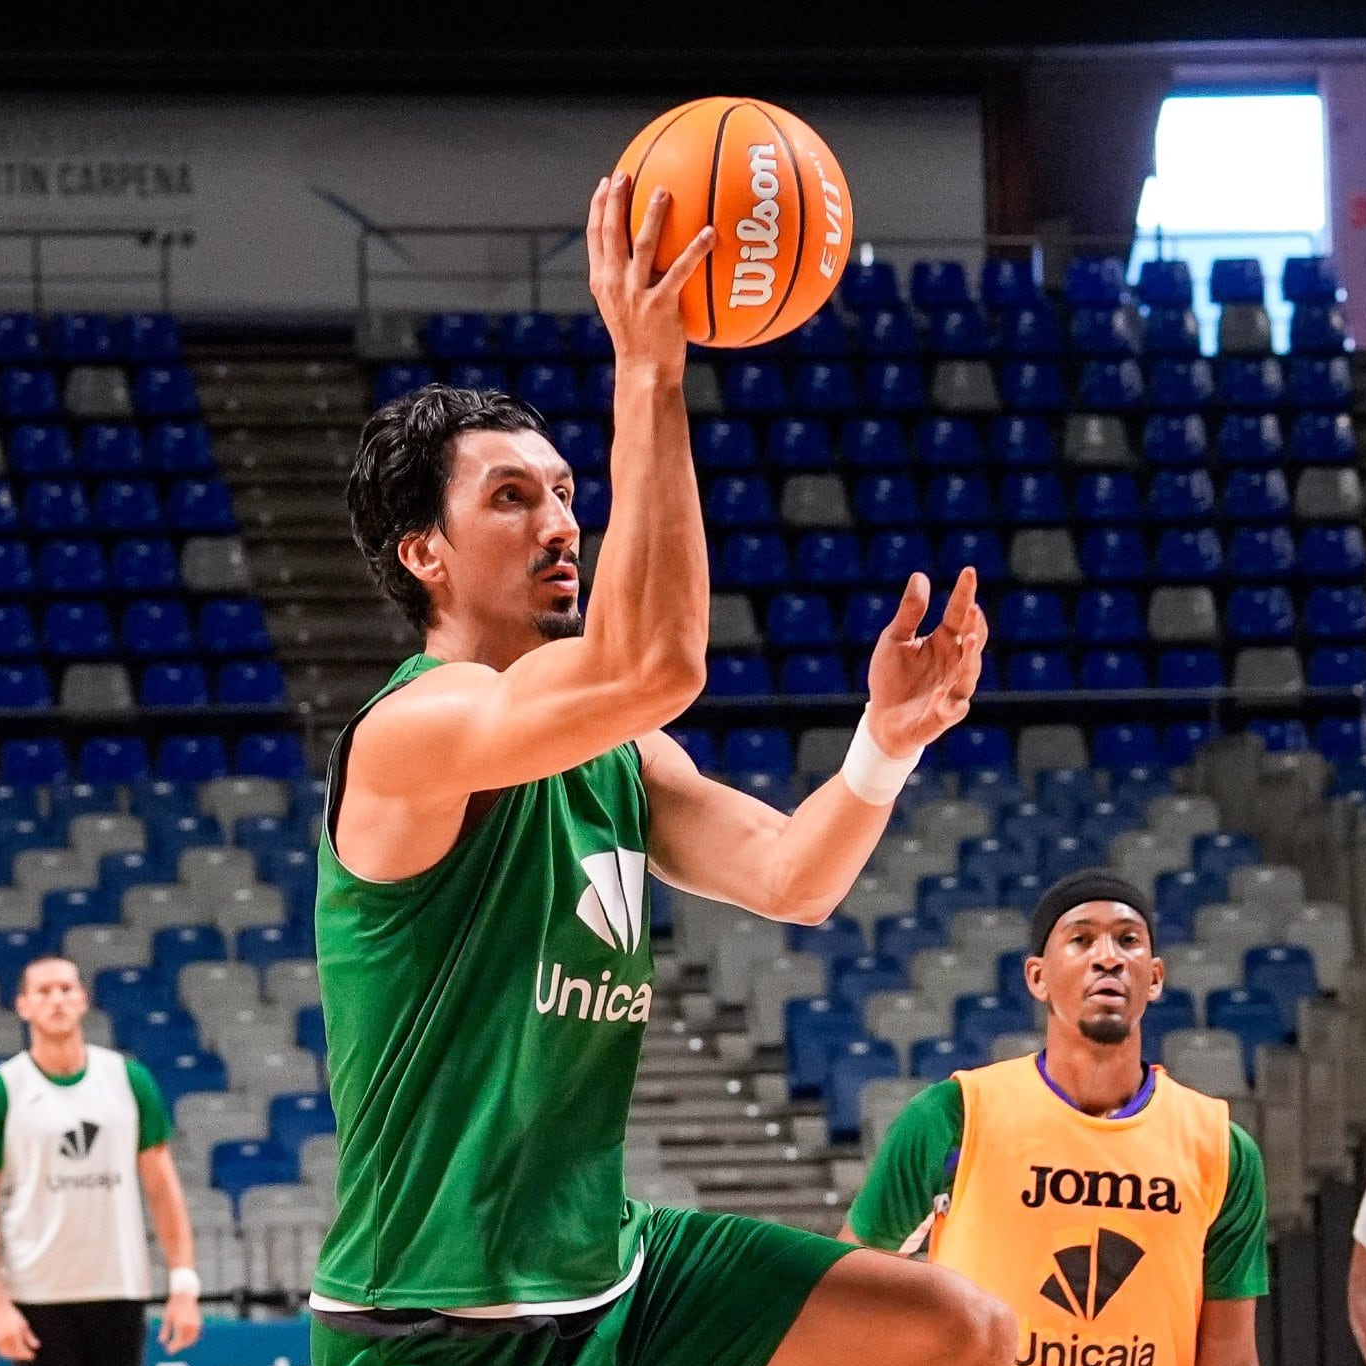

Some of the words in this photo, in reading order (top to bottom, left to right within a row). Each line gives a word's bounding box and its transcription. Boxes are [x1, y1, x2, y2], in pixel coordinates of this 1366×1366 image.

[58, 162, 194, 198] CARPENA
[728, 142, 781, 309] Wilson
[819, 179, 843, 279] EVO
[535, 960, 653, 1022] Unica
